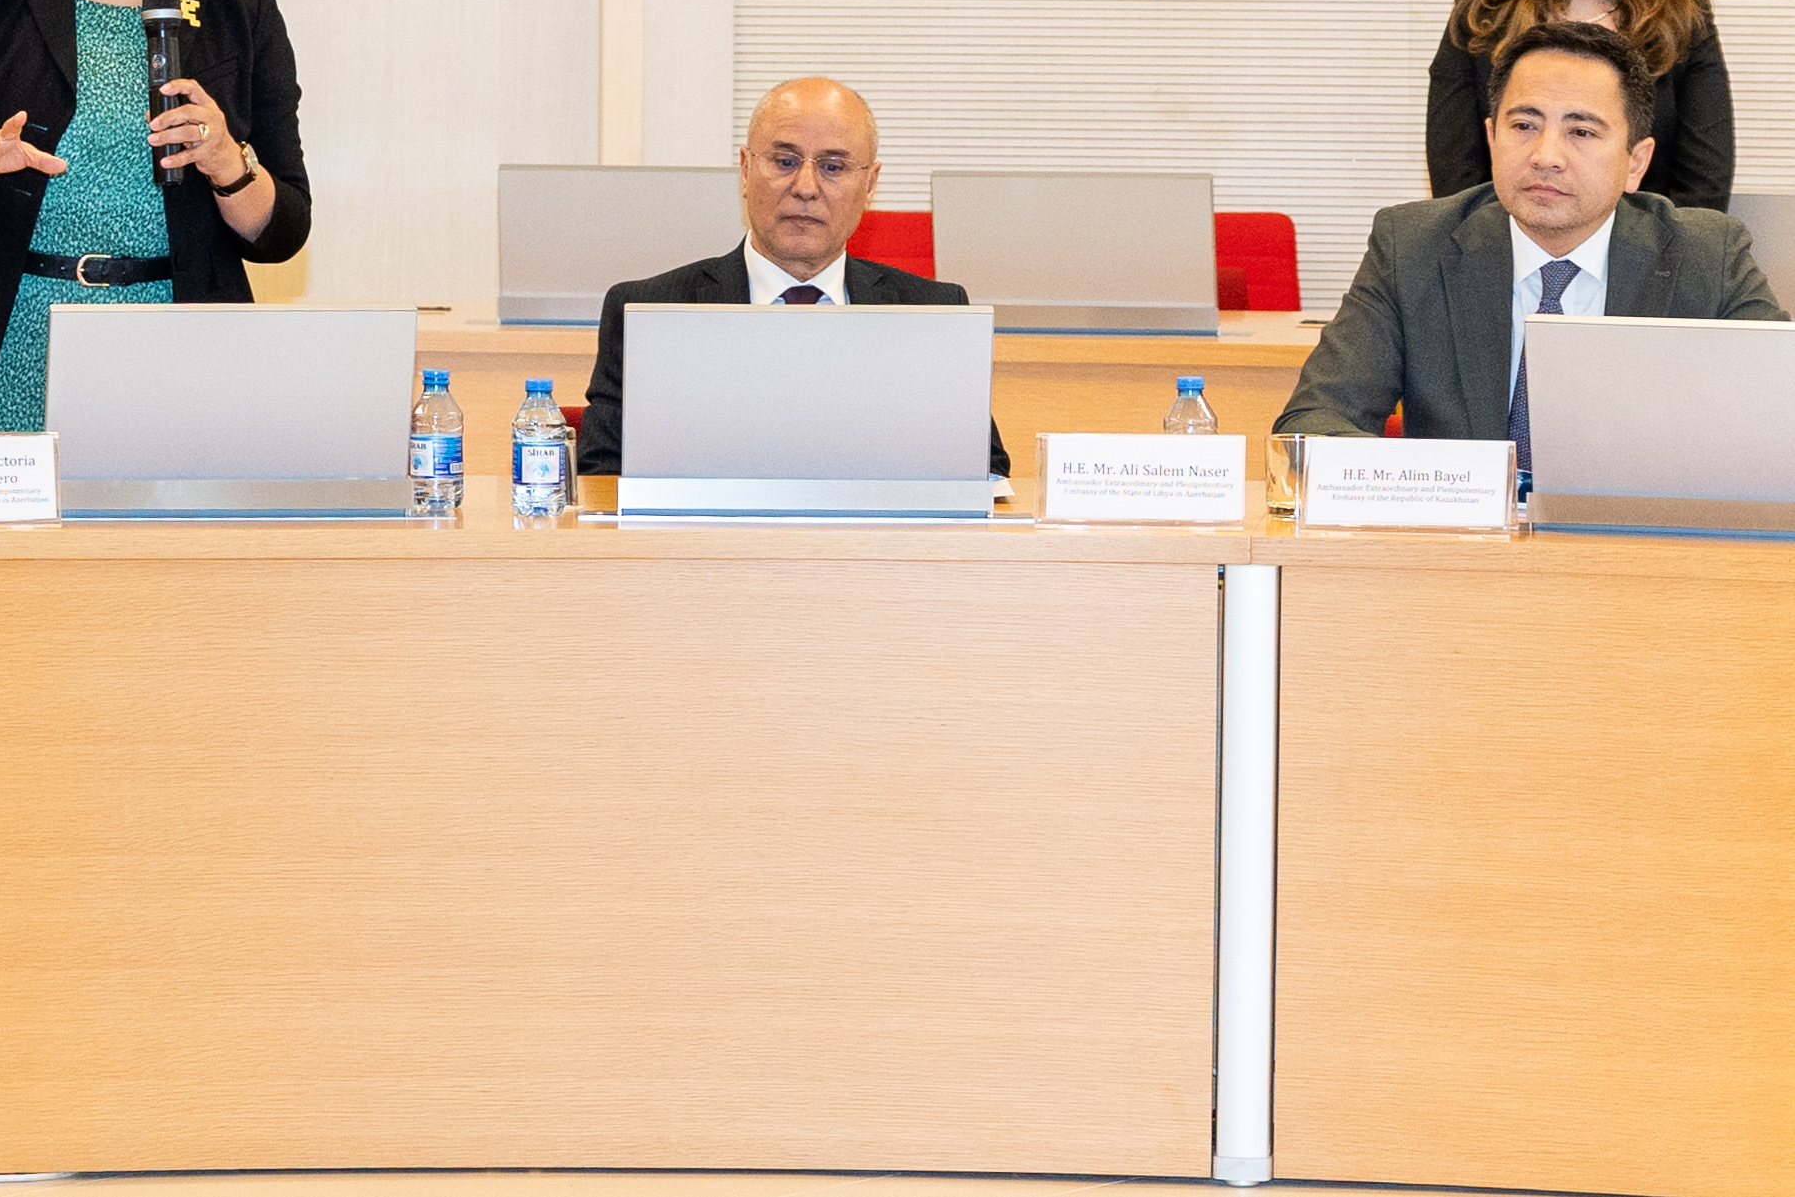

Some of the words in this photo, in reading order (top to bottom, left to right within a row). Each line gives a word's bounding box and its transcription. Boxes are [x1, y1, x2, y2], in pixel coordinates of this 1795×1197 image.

[1063, 462, 1088, 474] H.E.
[1094, 463, 1116, 474] Mr.
[1120, 463, 1138, 475] Ali
[1143, 464, 1184, 476] Salem
[1189, 465, 1229, 477] Naser
[1343, 469, 1368, 480] H.E.
[1373, 470, 1394, 481] Mr.
[1399, 470, 1429, 481] Alim
[1434, 471, 1470, 485] Bayel
[1056, 478, 1102, 486] Ambassador
[1105, 479, 1157, 488] Extraordinary
[1176, 481, 1234, 489] Plenipotentiary
[1064, 488, 1096, 496] Embassy
[1153, 490, 1173, 498] Libya
[1366, 485, 1418, 493] Extraordinary
[1437, 486, 1496, 495] Plenipotentiary
[1391, 495, 1424, 503] Republic
[1435, 496, 1478, 504] Kazakhstan
